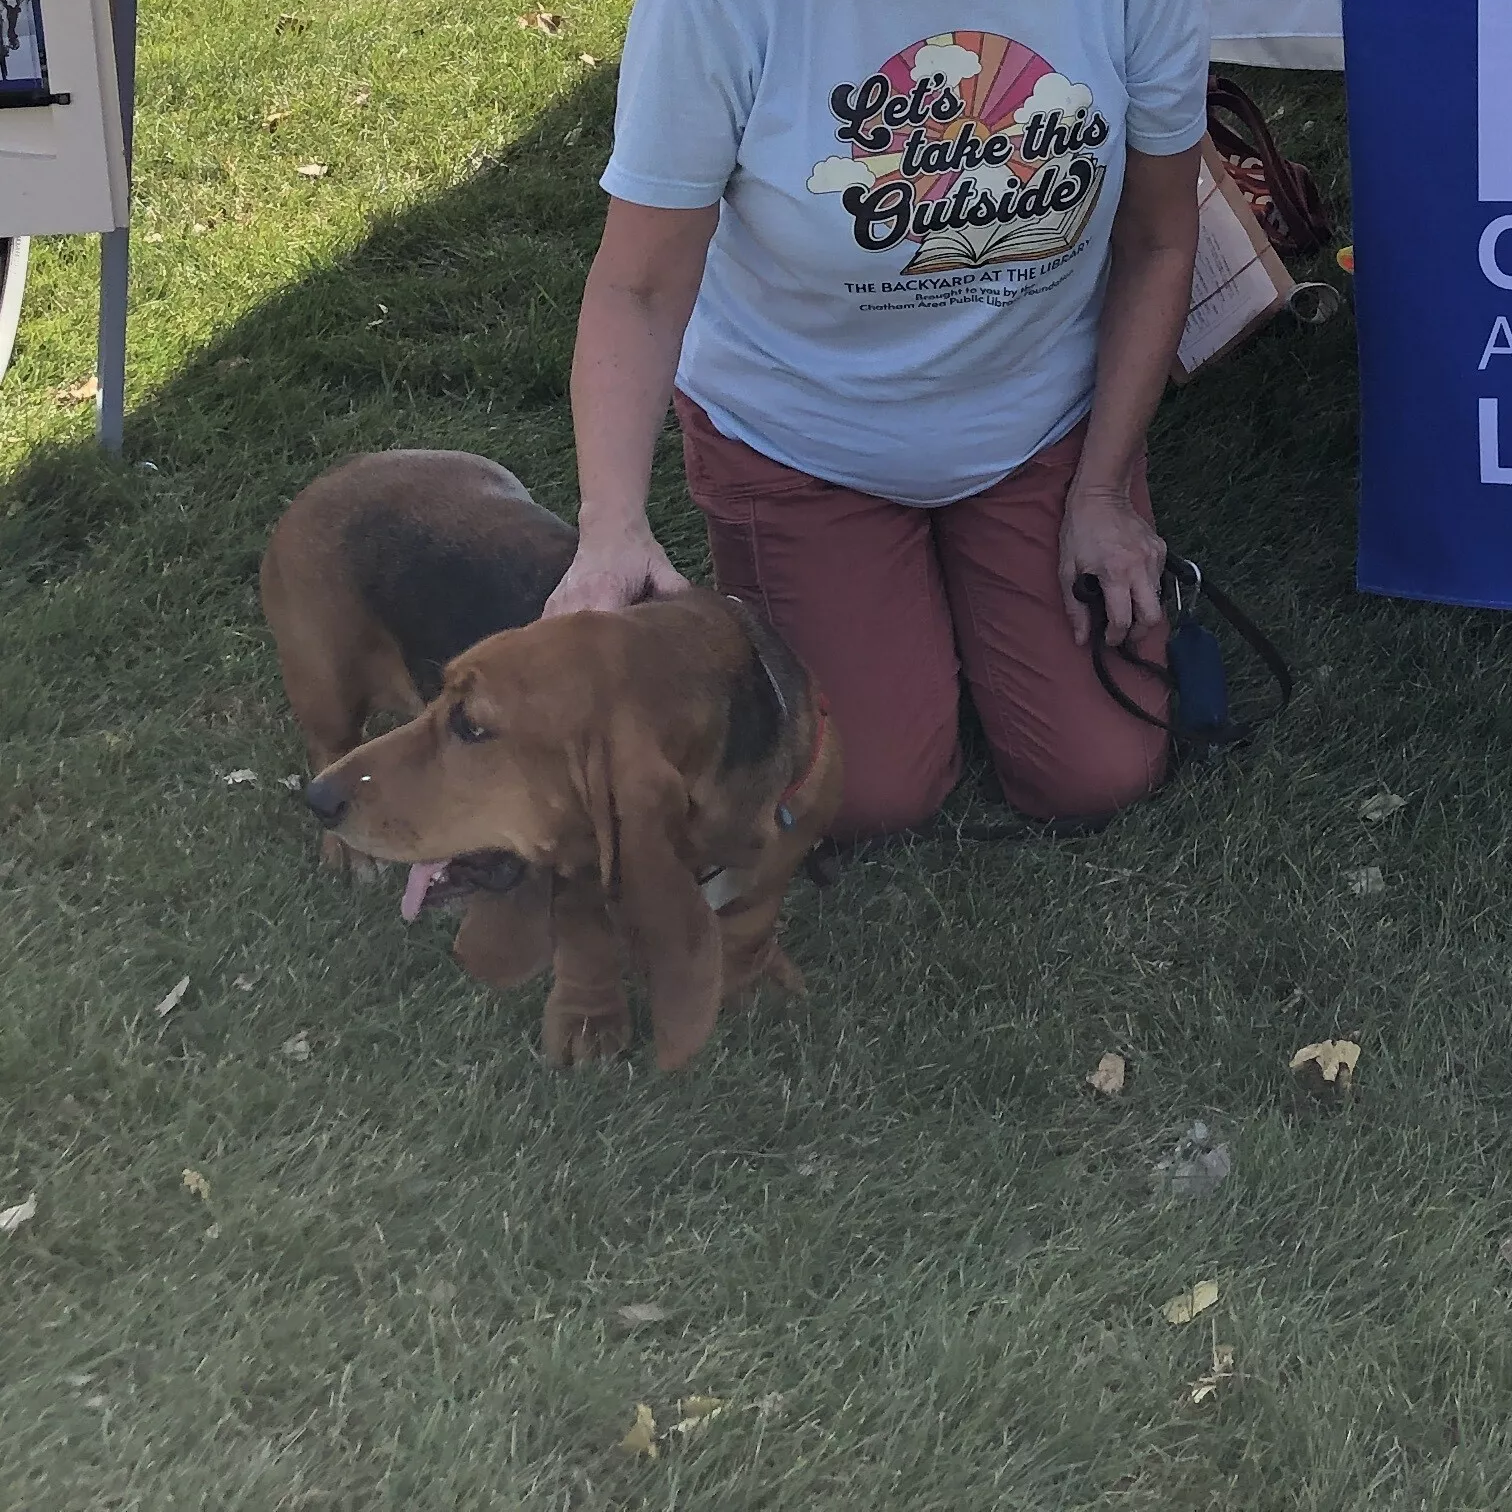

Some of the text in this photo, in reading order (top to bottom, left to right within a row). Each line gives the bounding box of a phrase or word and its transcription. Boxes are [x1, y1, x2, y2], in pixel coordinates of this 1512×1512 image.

[831, 72, 964, 152] Let's
[901, 109, 1109, 177] take this
[841, 158, 1094, 252] Outside
[844, 237, 1093, 294] THE BACKYARD AT THE LIBRARY
[915, 287, 963, 301] Brought
[965, 286, 978, 294] to
[979, 287, 1001, 298] you
[1003, 287, 1018, 299] by
[859, 302, 915, 312] Chatham
[918, 300, 946, 309] Area
[949, 295, 984, 305] Public
